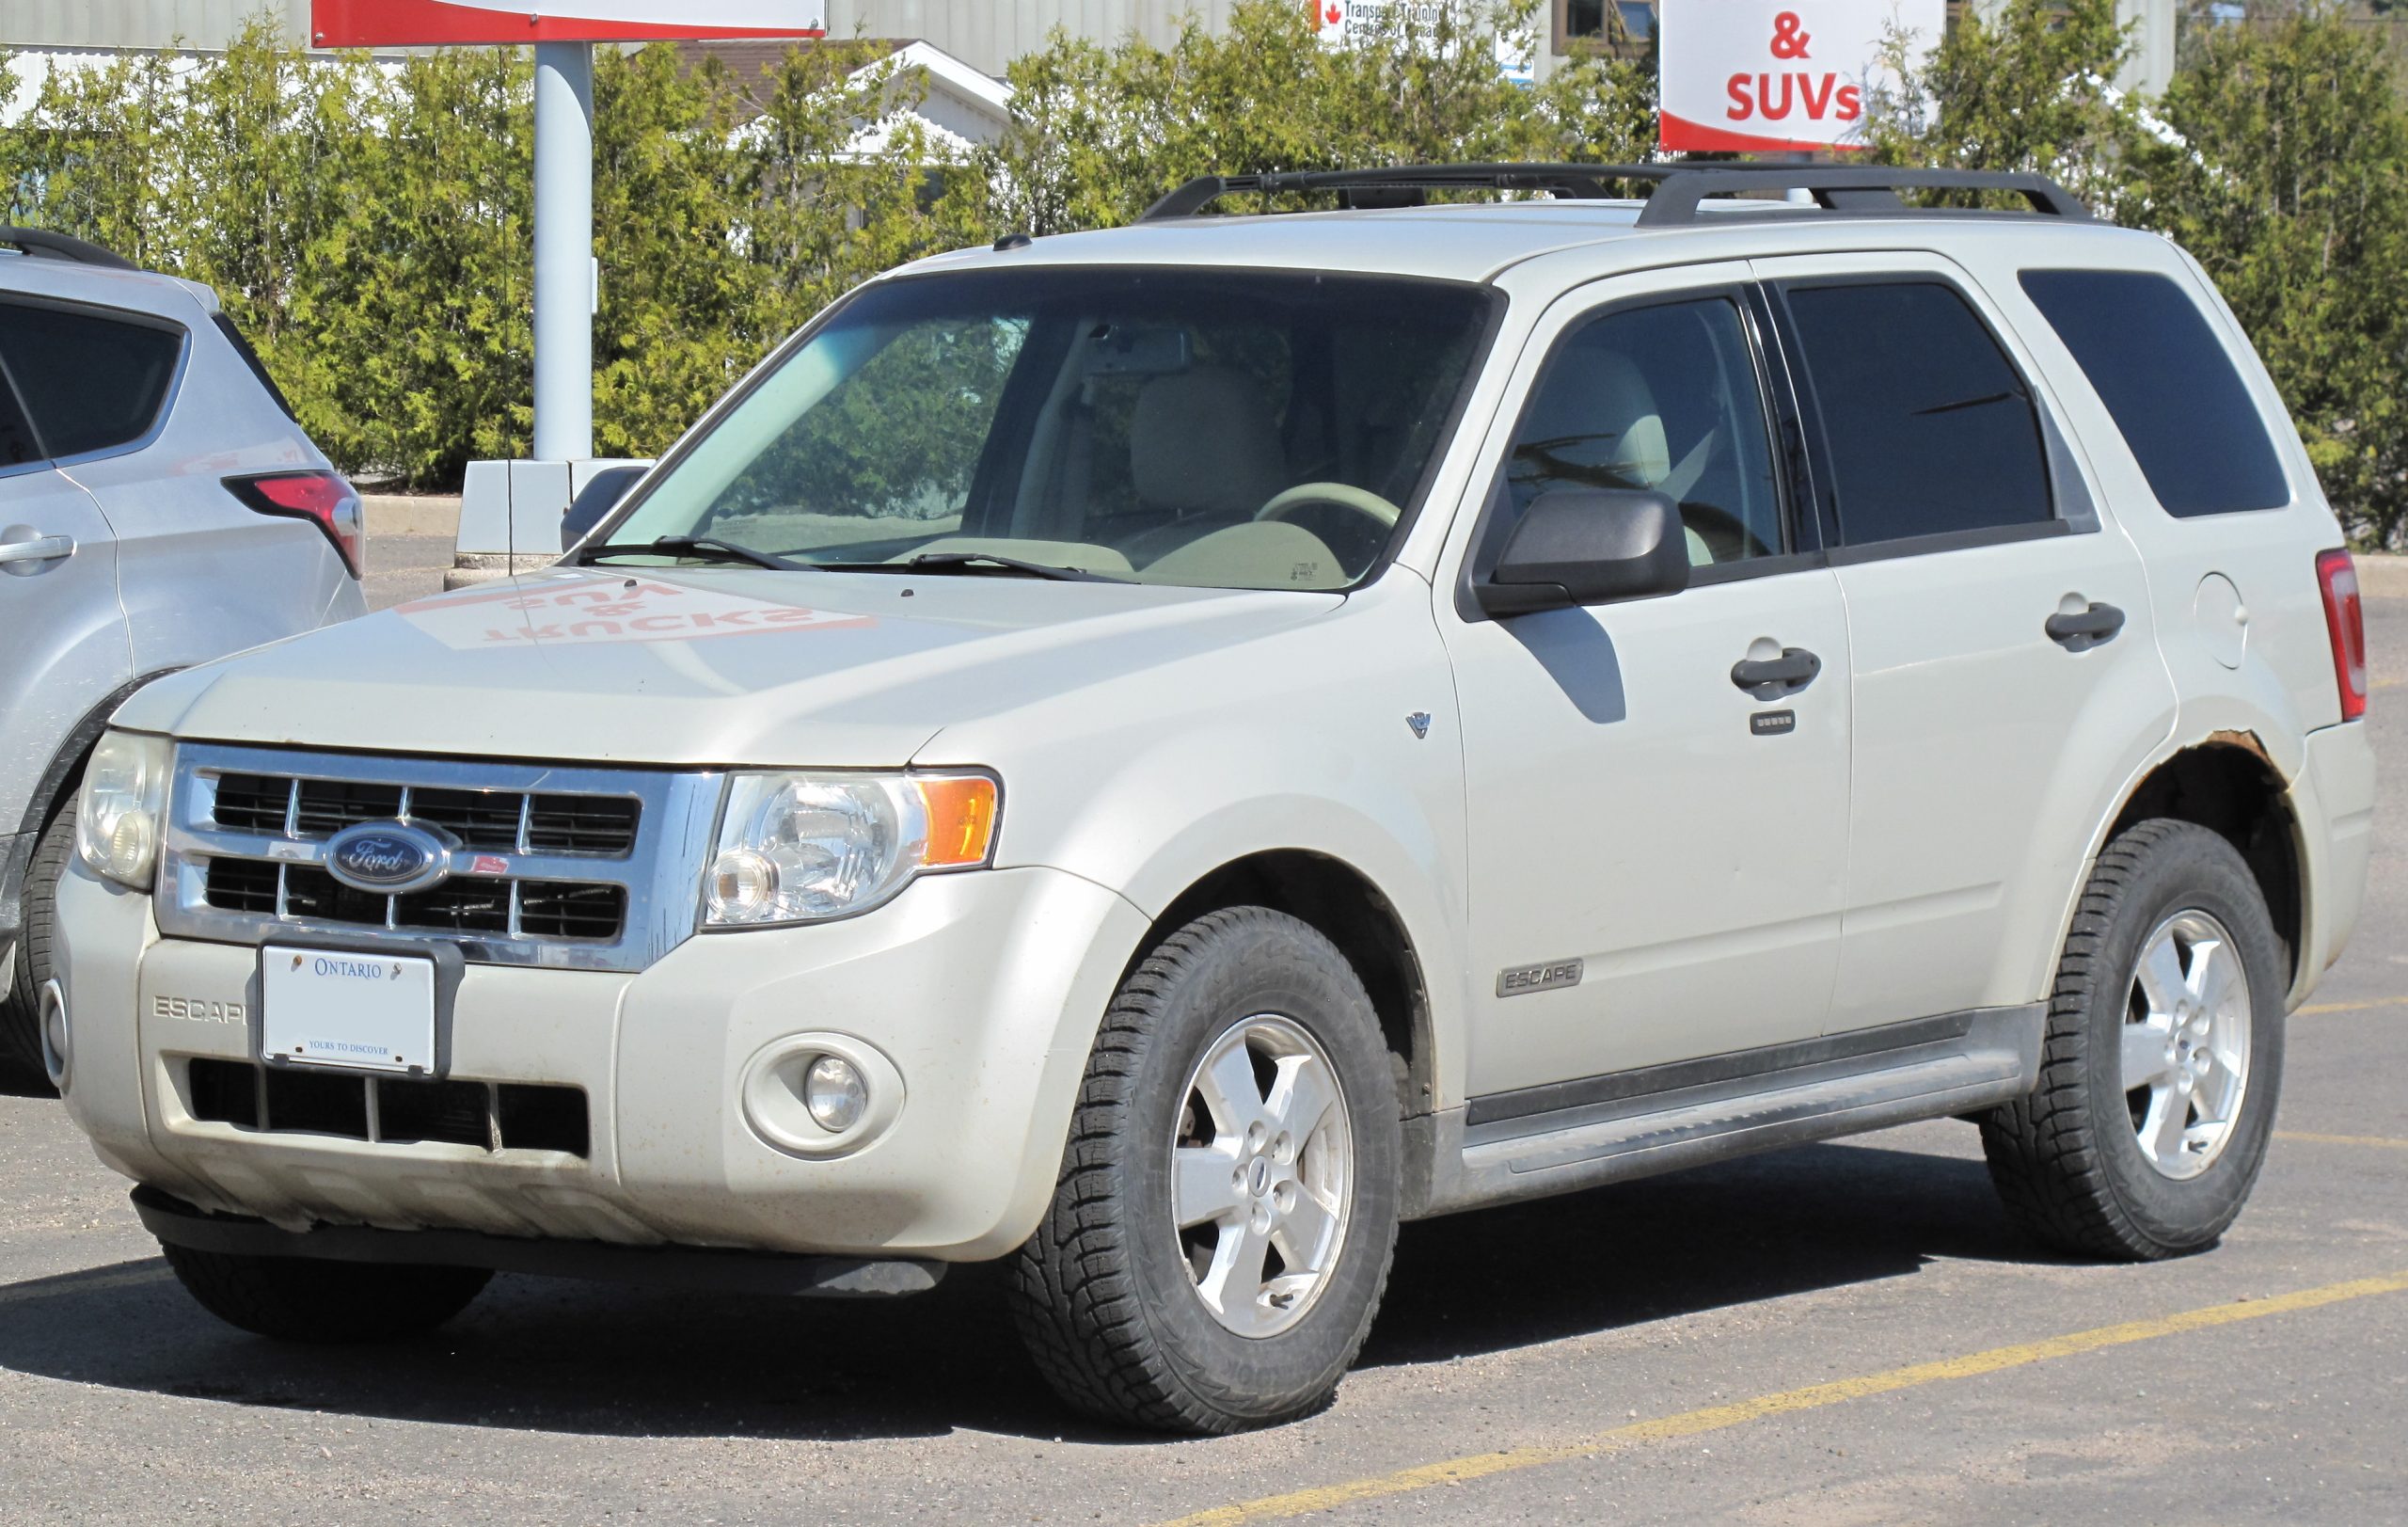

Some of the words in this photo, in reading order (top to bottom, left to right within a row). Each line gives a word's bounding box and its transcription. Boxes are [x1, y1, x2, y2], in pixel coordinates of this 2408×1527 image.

[1770, 11, 1811, 59] &
[1727, 72, 1861, 120] SUVs
[349, 839, 404, 872] Ford
[314, 958, 382, 979] ONTARIO
[1505, 964, 1577, 989] ESCAPE
[153, 995, 246, 1025] ESCAP
[309, 1040, 335, 1050] YOURS
[338, 1042, 348, 1052] TO
[350, 1044, 389, 1055] DISCOVER
